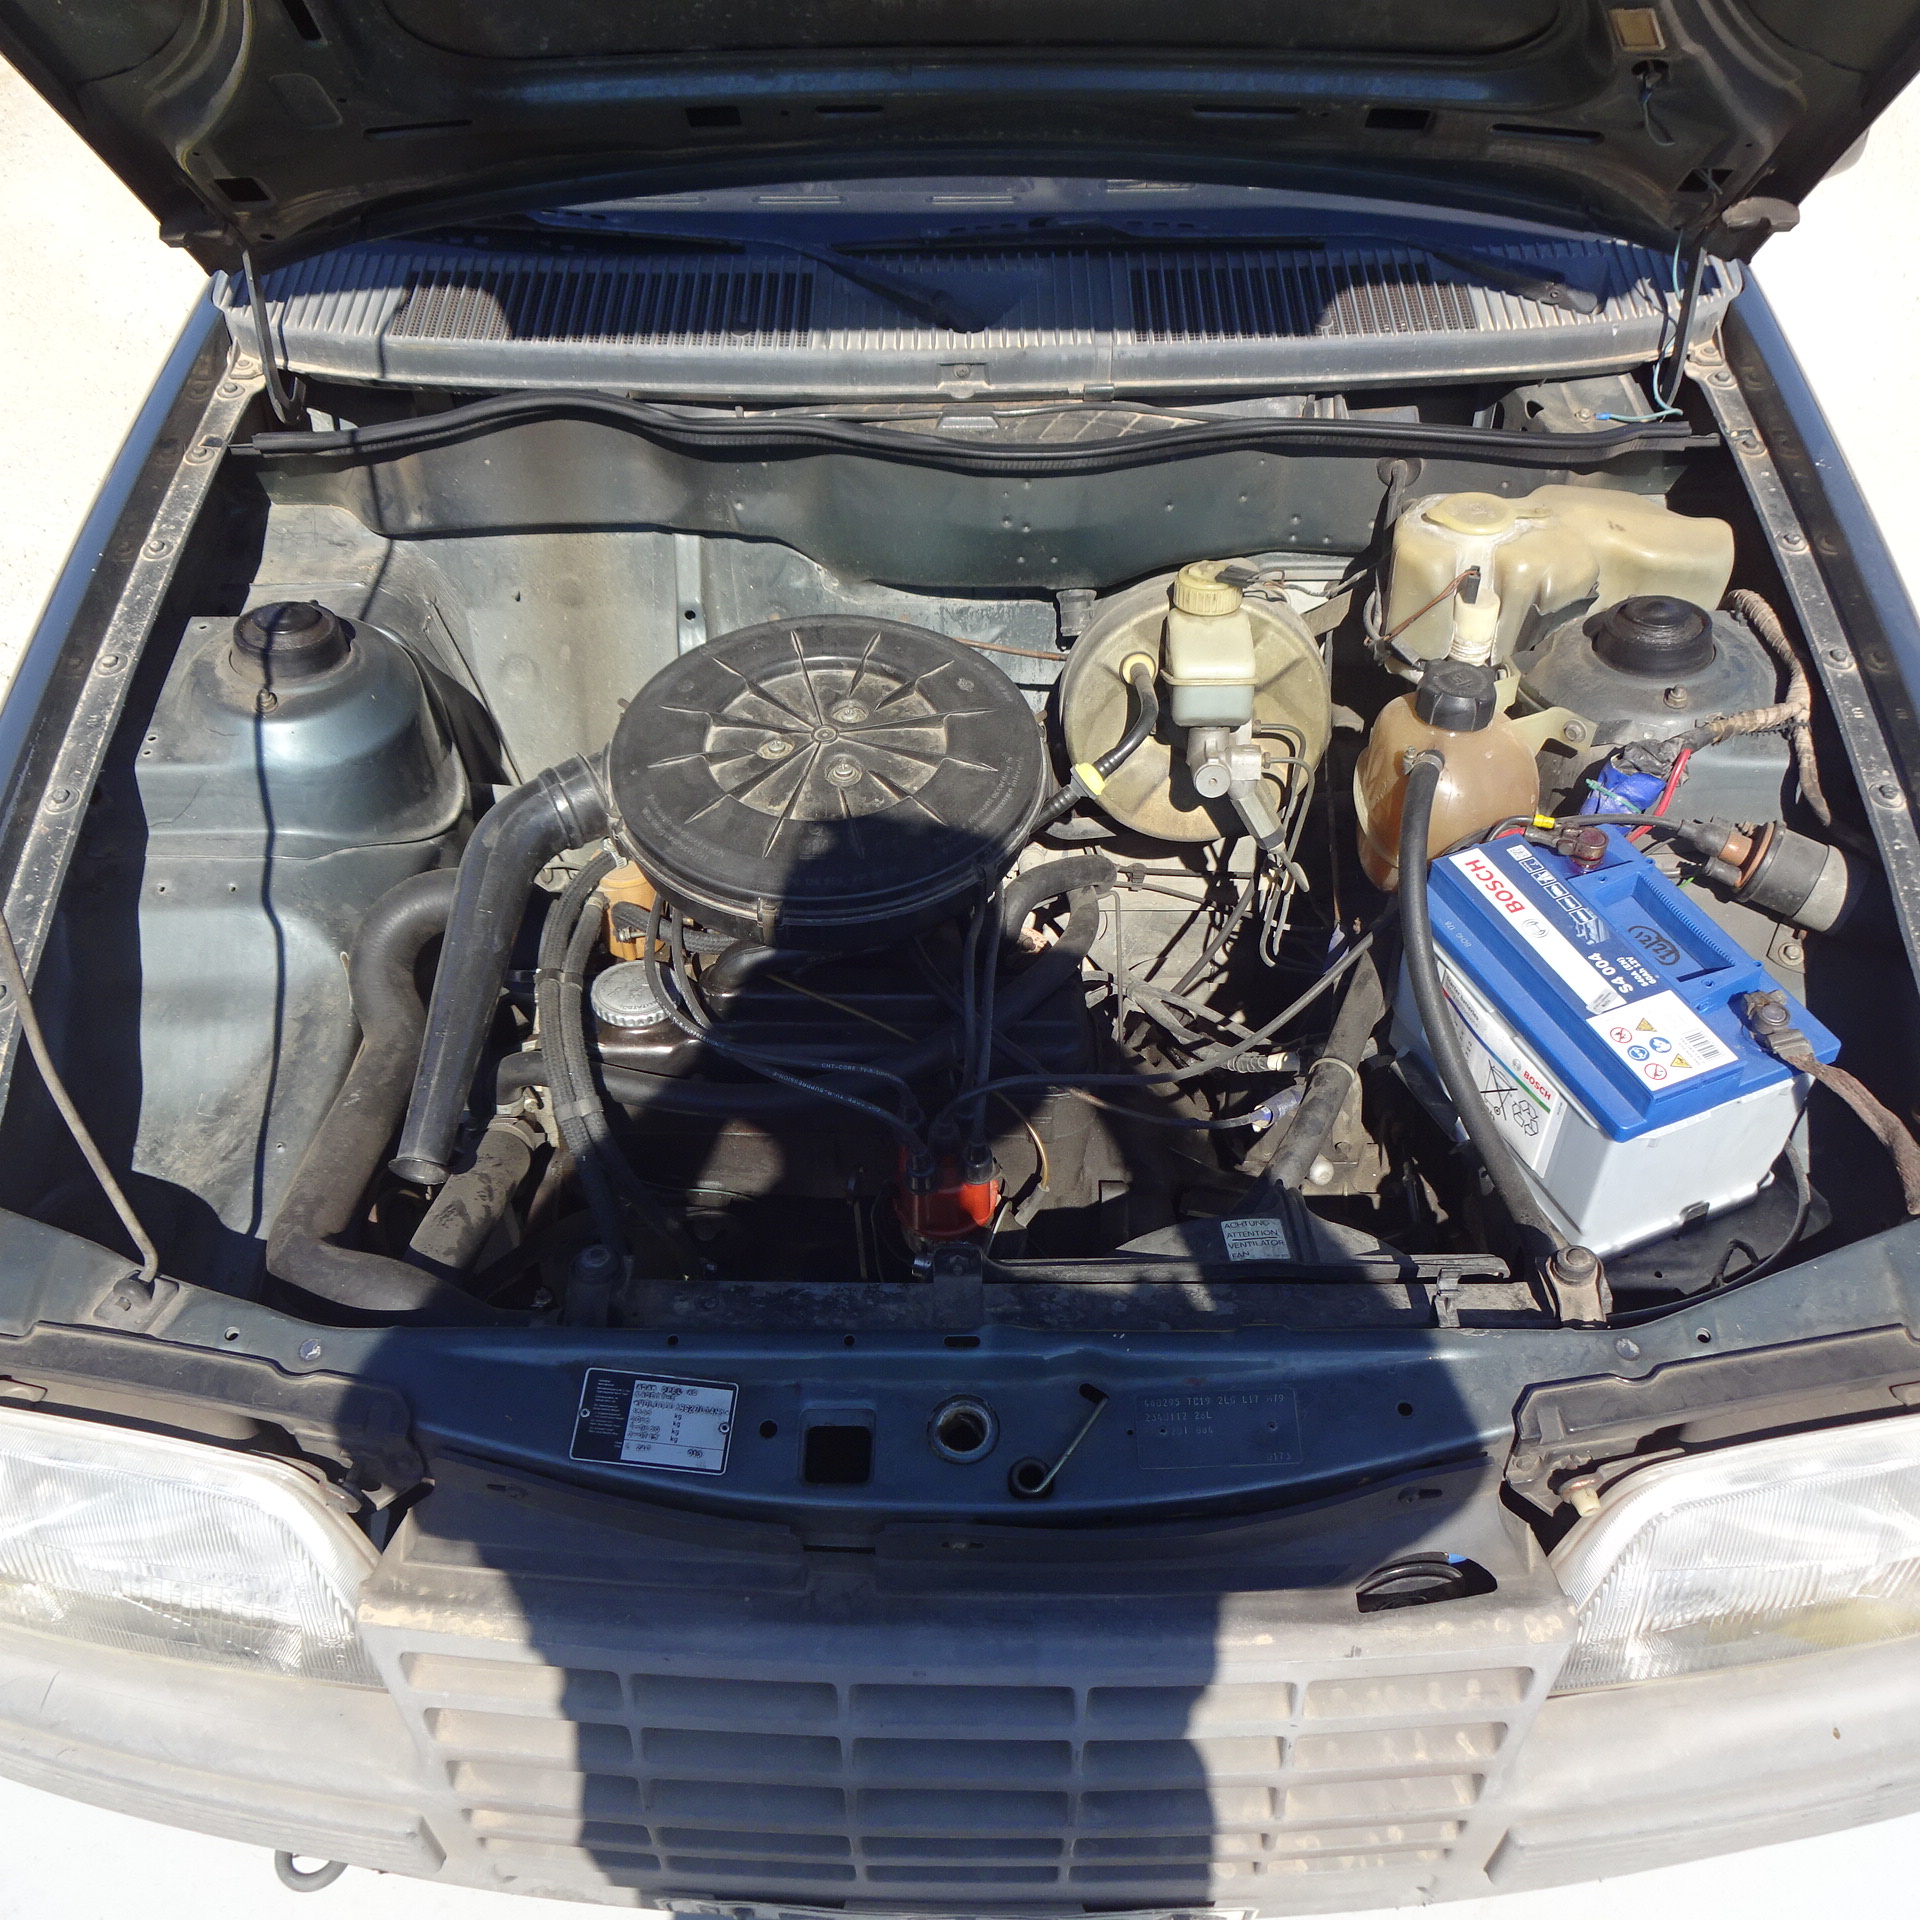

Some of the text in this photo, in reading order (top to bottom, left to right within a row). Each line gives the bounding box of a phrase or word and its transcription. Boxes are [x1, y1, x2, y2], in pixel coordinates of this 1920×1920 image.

[1464, 858, 1526, 914] BOSCH
[1588, 953, 1634, 993] S4 004
[1523, 1071, 1552, 1101] BOSCH
[1224, 1219, 1270, 1229] ACHTUNG
[1226, 1229, 1279, 1239] ATTENTION
[1228, 1239, 1284, 1249] VENTILATOR
[1232, 1250, 1250, 1259] FAN
[673, 1420, 680, 1428] kg
